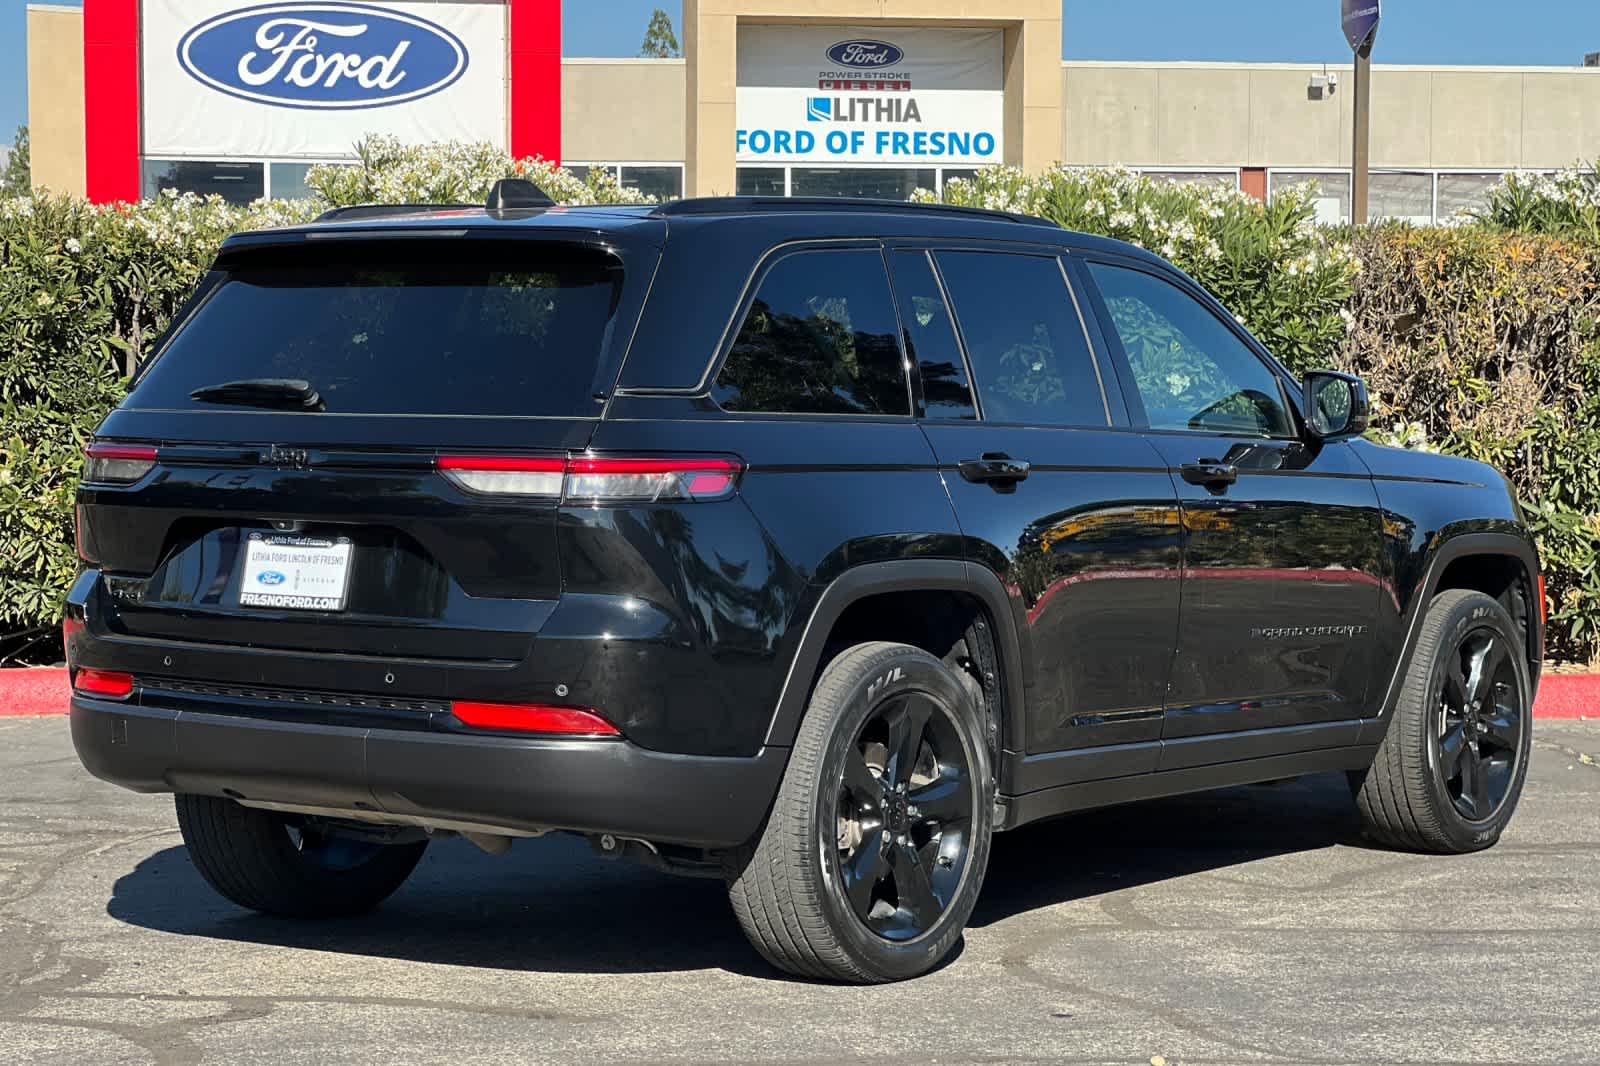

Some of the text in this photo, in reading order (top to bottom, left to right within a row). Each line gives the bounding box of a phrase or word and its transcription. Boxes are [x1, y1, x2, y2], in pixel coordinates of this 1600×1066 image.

[237, 18, 411, 90] Ford
[841, 43, 889, 64] Ford
[819, 71, 911, 80] POWER STROKE
[822, 80, 910, 90] DIESEL
[834, 97, 922, 122] LITHIA
[736, 129, 995, 156] FORD OF FRESNO
[252, 551, 344, 566] LITHIA FORD LINCOLN OF FRESNO
[240, 593, 340, 610] FRESNOFORD.COM
